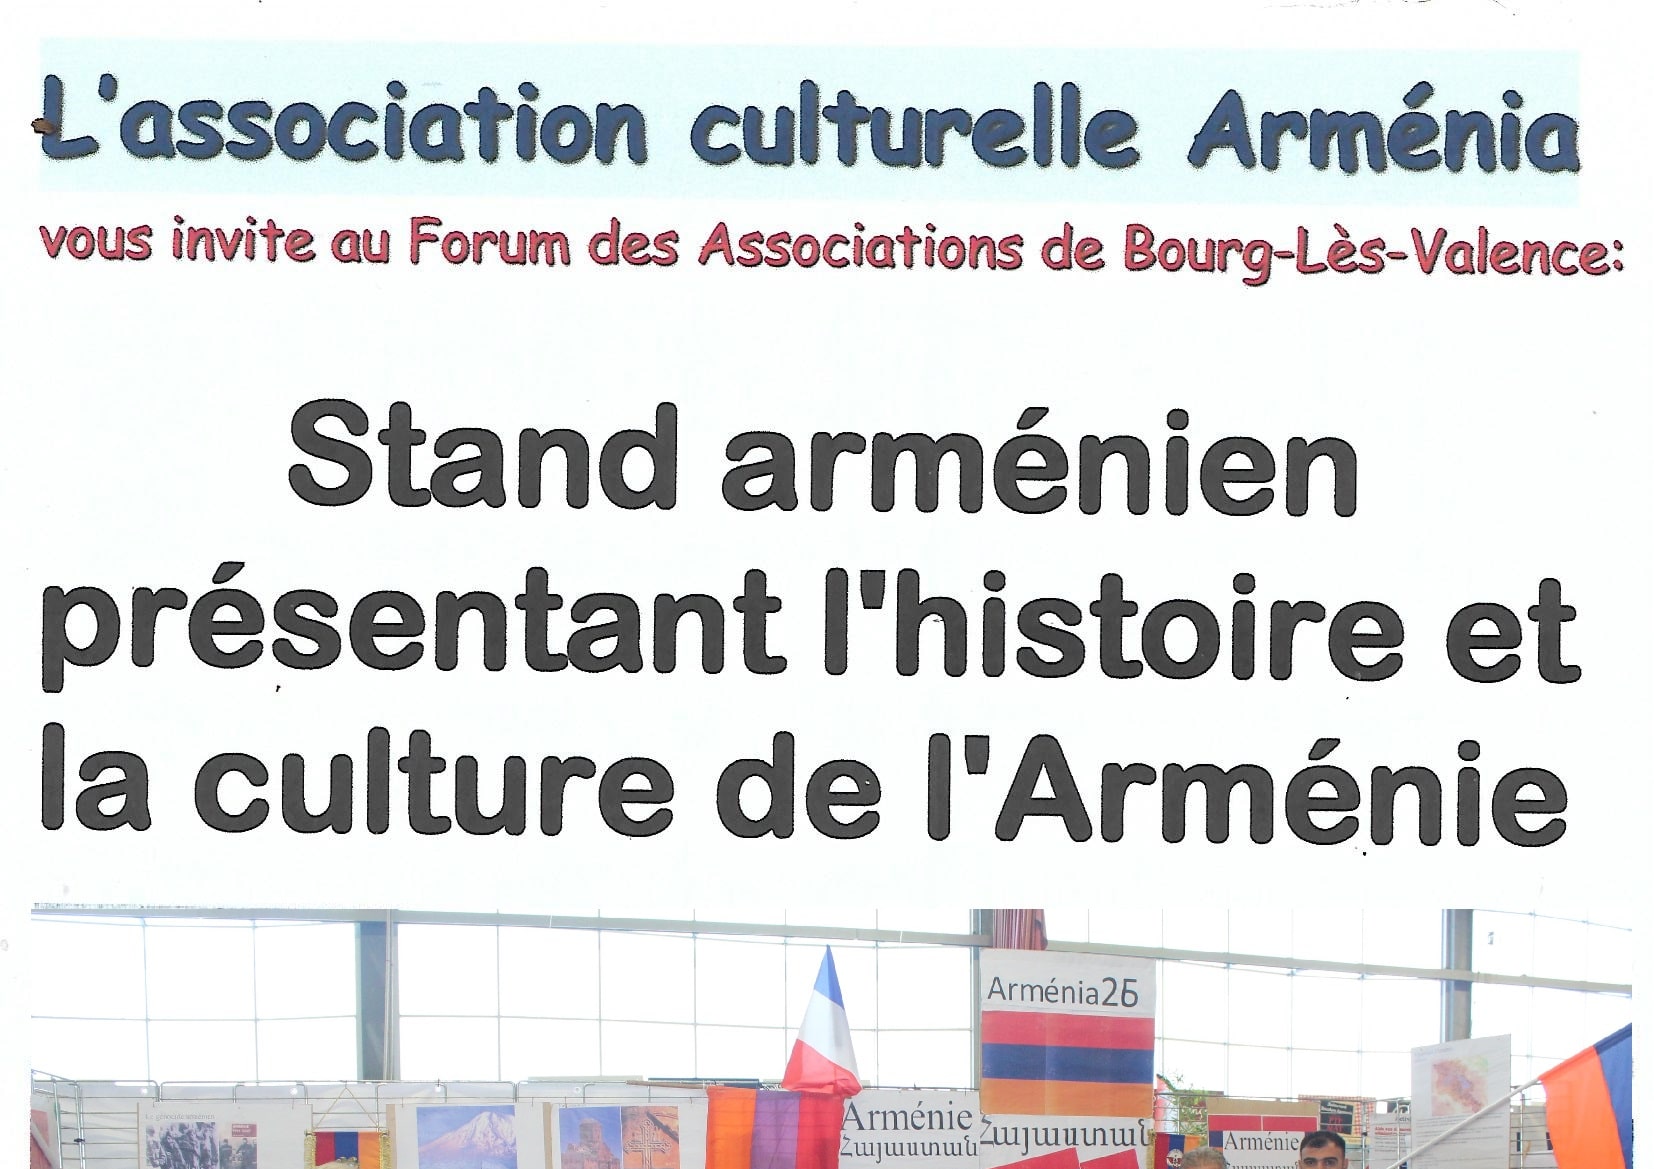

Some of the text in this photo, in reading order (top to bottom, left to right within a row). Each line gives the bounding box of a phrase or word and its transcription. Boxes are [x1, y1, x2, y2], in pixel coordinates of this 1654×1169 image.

[40, 73, 1580, 175] L'association culturelle Arménia
[39, 215, 1624, 287] vous invite au Forum des Associations de Bourg-Lès-Valence:
[289, 398, 1357, 517] Stand arménien
[42, 561, 1581, 693] présentant l'histoire et
[42, 722, 1567, 847] la culture de l'Arménie
[840, 1134, 979, 1164] Հայաստան
[841, 1100, 973, 1131] Arménie
[1223, 1131, 1300, 1151] Arménie
